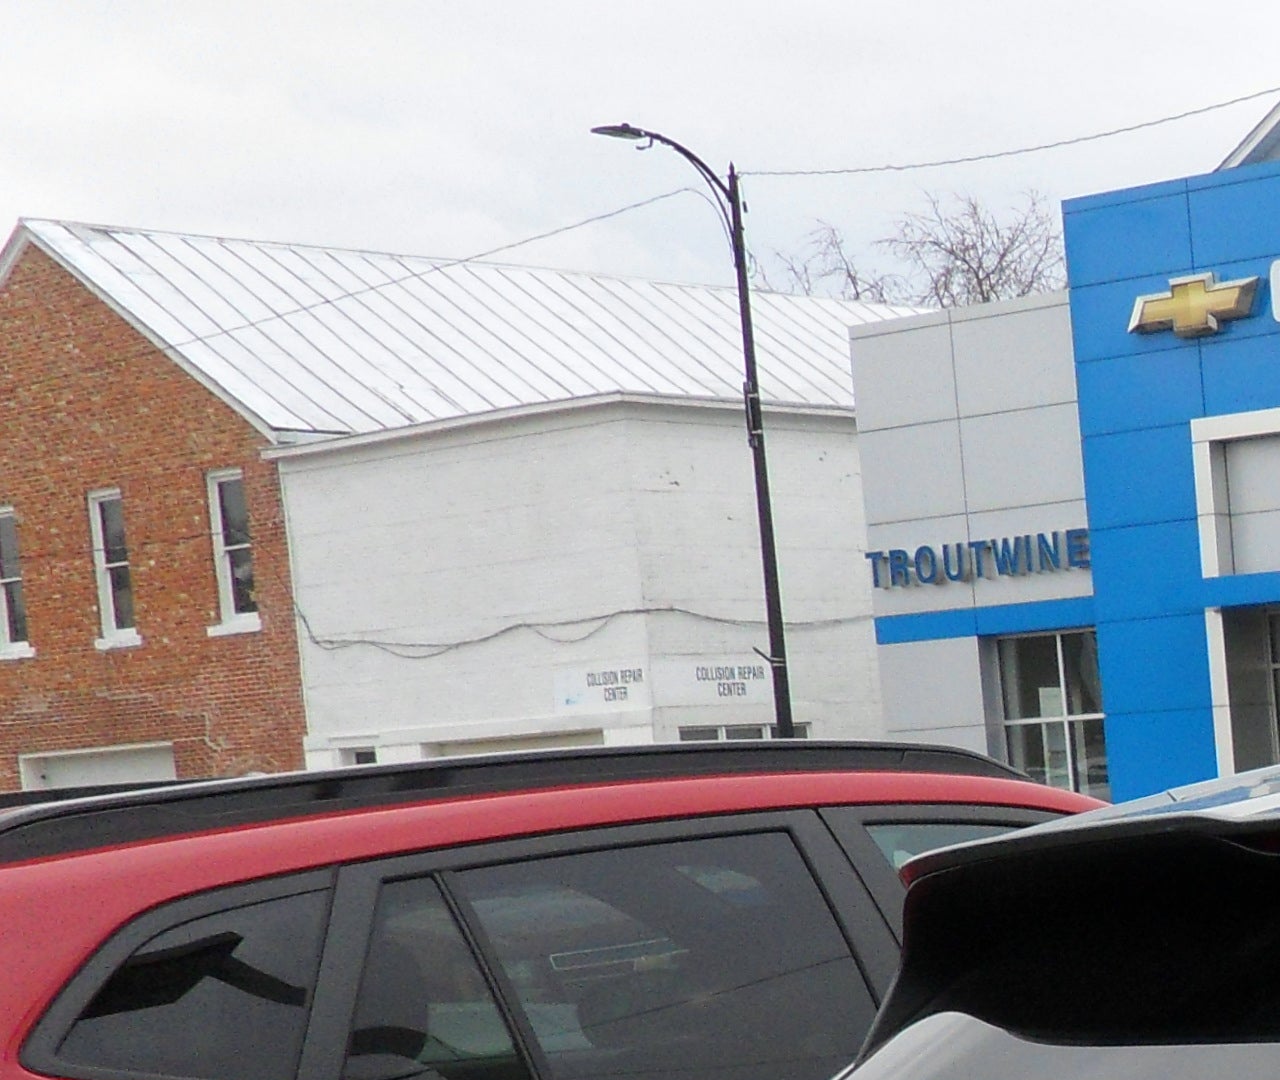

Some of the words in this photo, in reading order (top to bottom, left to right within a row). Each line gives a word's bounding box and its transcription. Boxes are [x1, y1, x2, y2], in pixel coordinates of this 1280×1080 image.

[865, 527, 1090, 589] TROUTWINE
[586, 670, 618, 687] COLLISION
[620, 668, 643, 684] REPAIR
[695, 666, 735, 681] COLLISION
[738, 665, 765, 680] REPAIR
[603, 686, 628, 702] CENTER
[717, 682, 746, 697] CENTER
